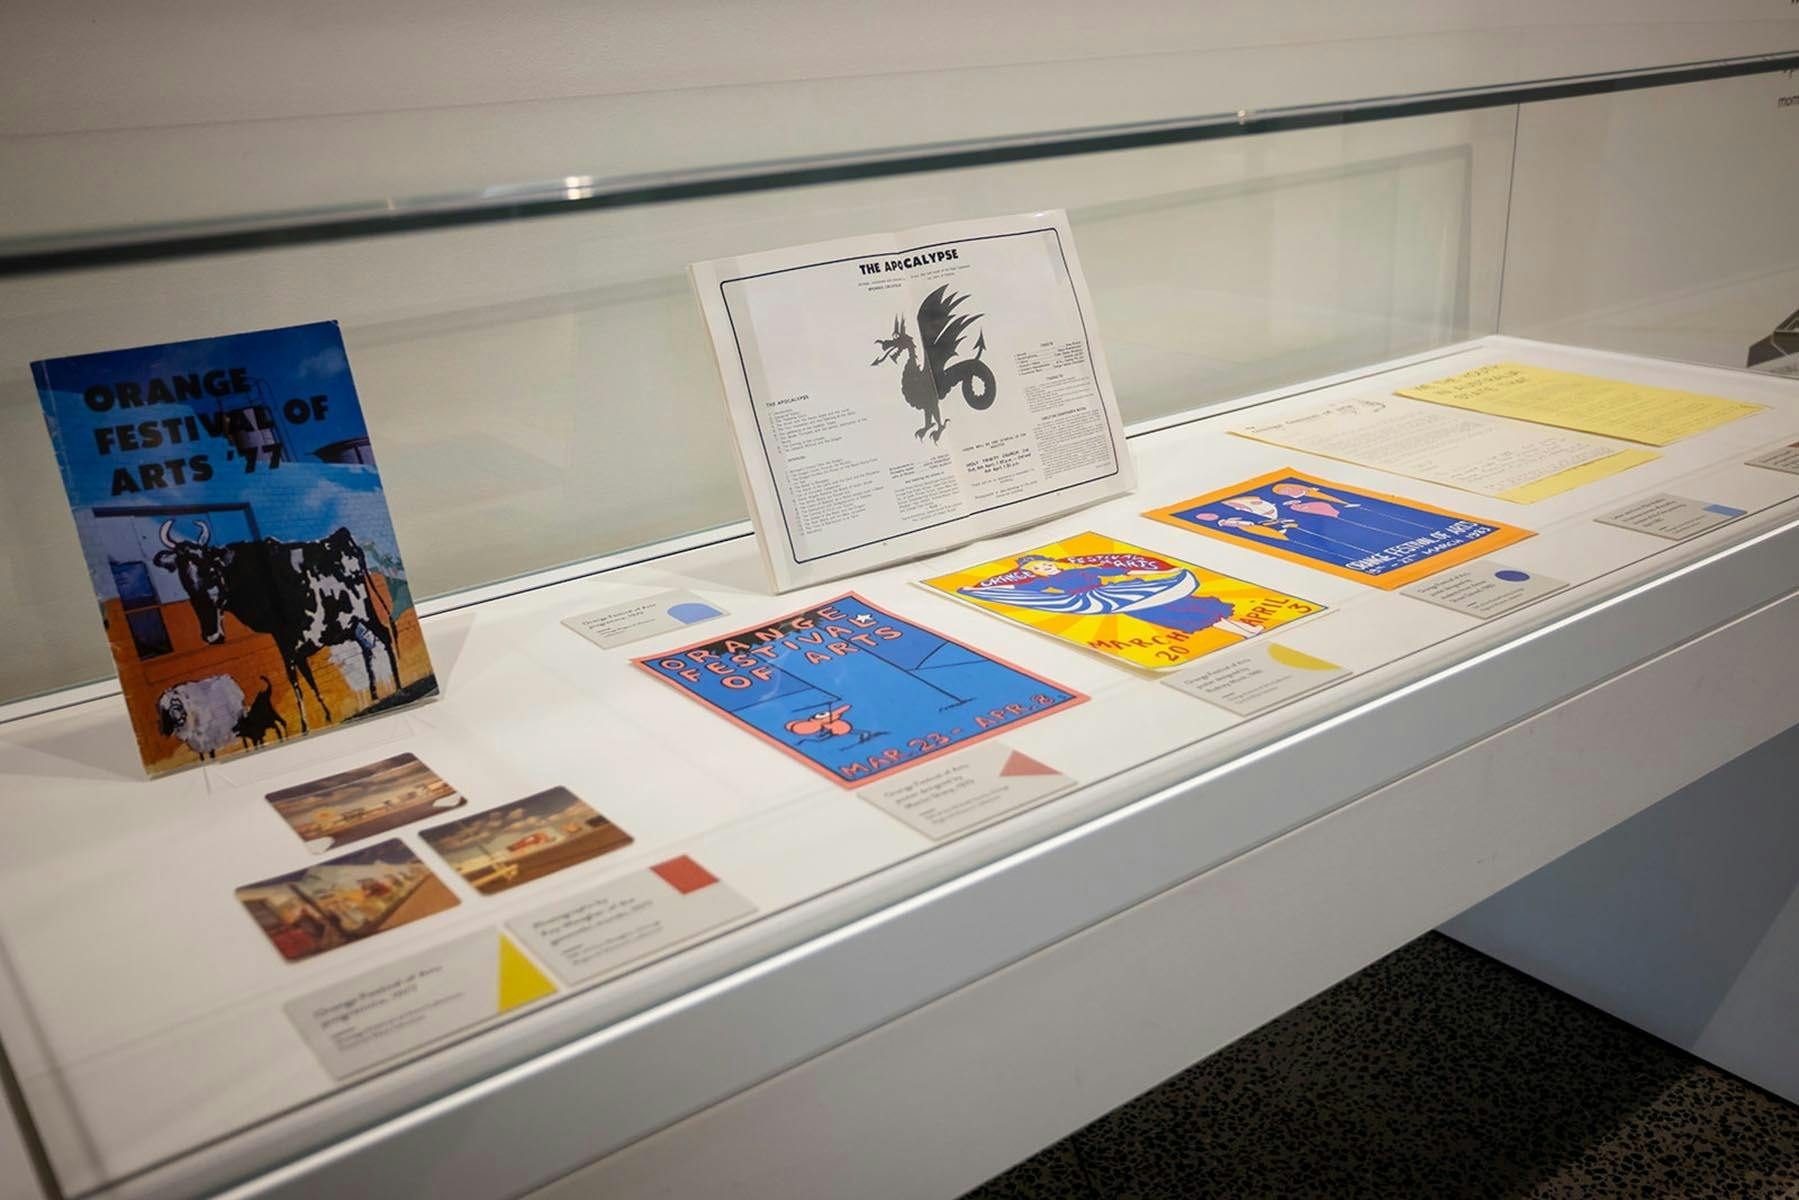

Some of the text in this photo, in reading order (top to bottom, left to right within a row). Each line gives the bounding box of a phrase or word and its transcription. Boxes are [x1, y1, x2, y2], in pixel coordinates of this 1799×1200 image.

[859, 249, 959, 275] THE APOCALYPSE
[83, 367, 253, 413] ORANGE
[93, 395, 328, 456] FESTIVAL OF
[111, 443, 284, 496] ARTS '77
[1345, 520, 1479, 571] ORANGE FESTIVAL OF ARTS
[1421, 539, 1463, 555] MARCH
[980, 570, 1037, 588] ORANGE
[1067, 554, 1145, 564] FESTIVAL
[1112, 559, 1159, 570] ARTS
[1239, 598, 1313, 628] APRIL 3
[658, 606, 850, 671] ORANGE
[678, 613, 878, 683] FESTIVAL
[720, 626, 905, 690] OF ARTS
[1088, 630, 1190, 650] MARCH
[1155, 645, 1191, 662] 20
[907, 731, 950, 751] 23
